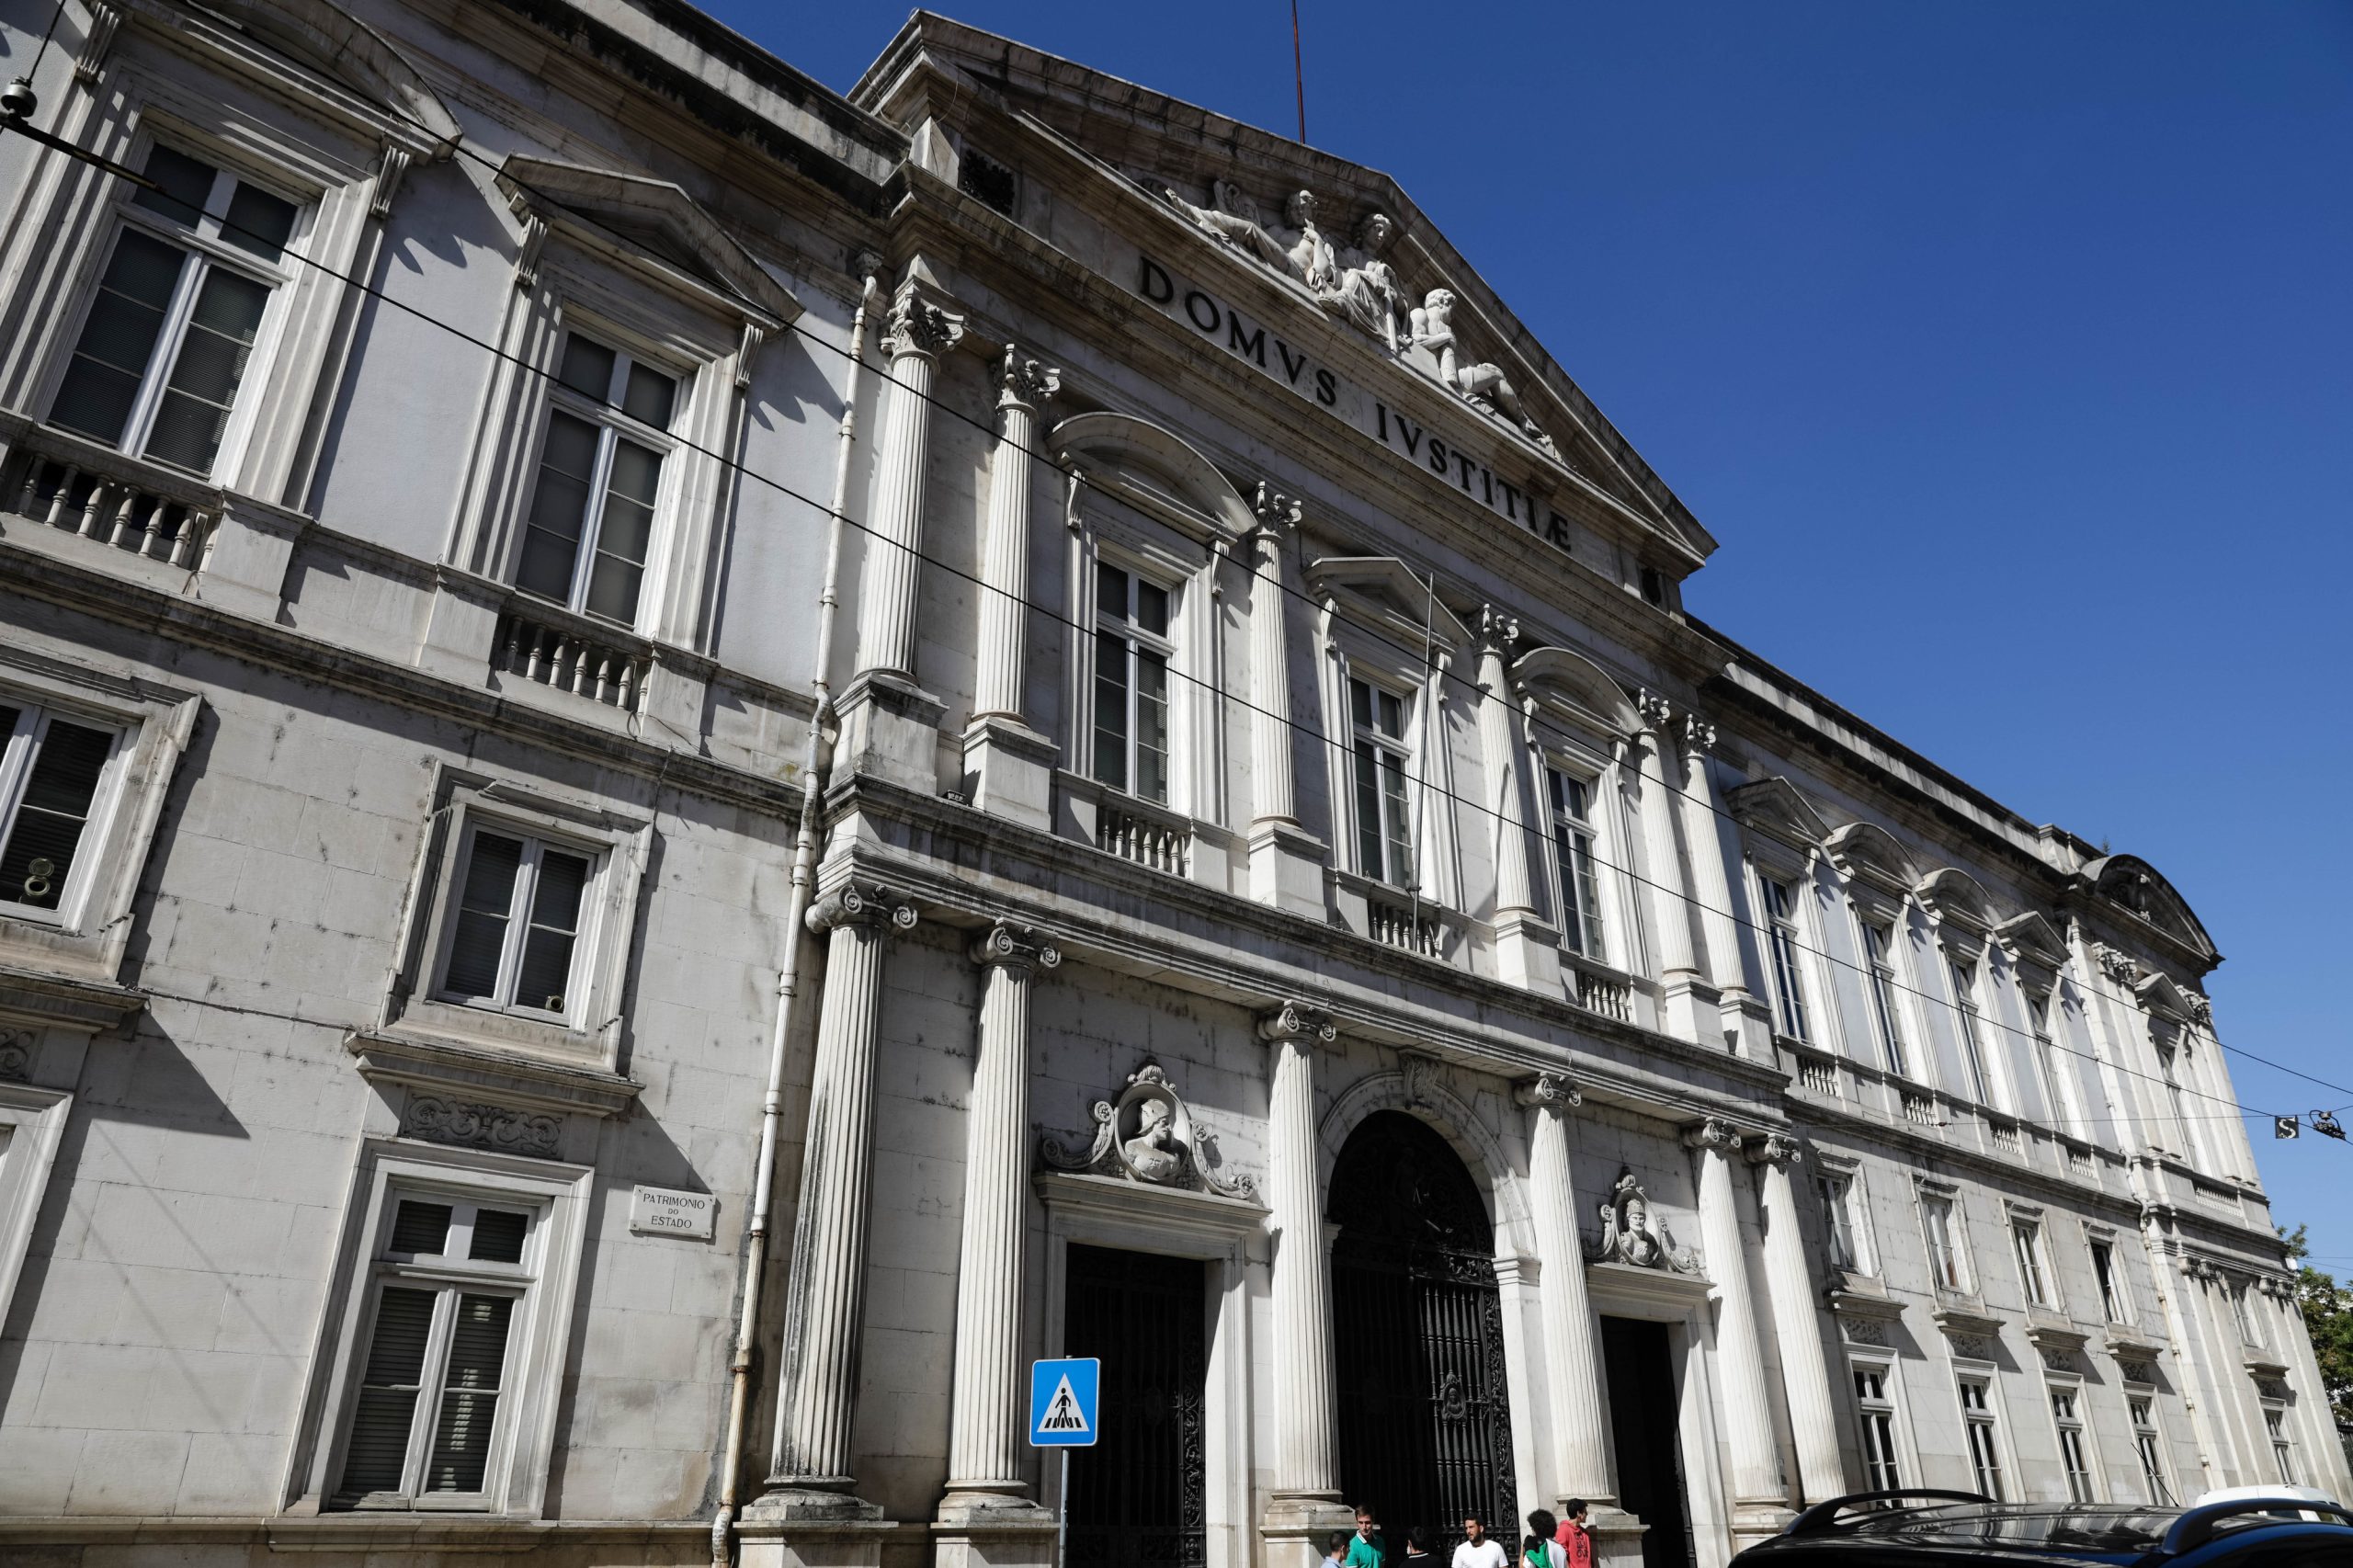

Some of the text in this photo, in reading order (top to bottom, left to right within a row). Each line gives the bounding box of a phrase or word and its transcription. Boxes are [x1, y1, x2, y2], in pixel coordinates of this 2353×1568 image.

[1140, 256, 1571, 552] DOMVS IVSTITIÆ
[651, 1215, 692, 1229] ESTADO
